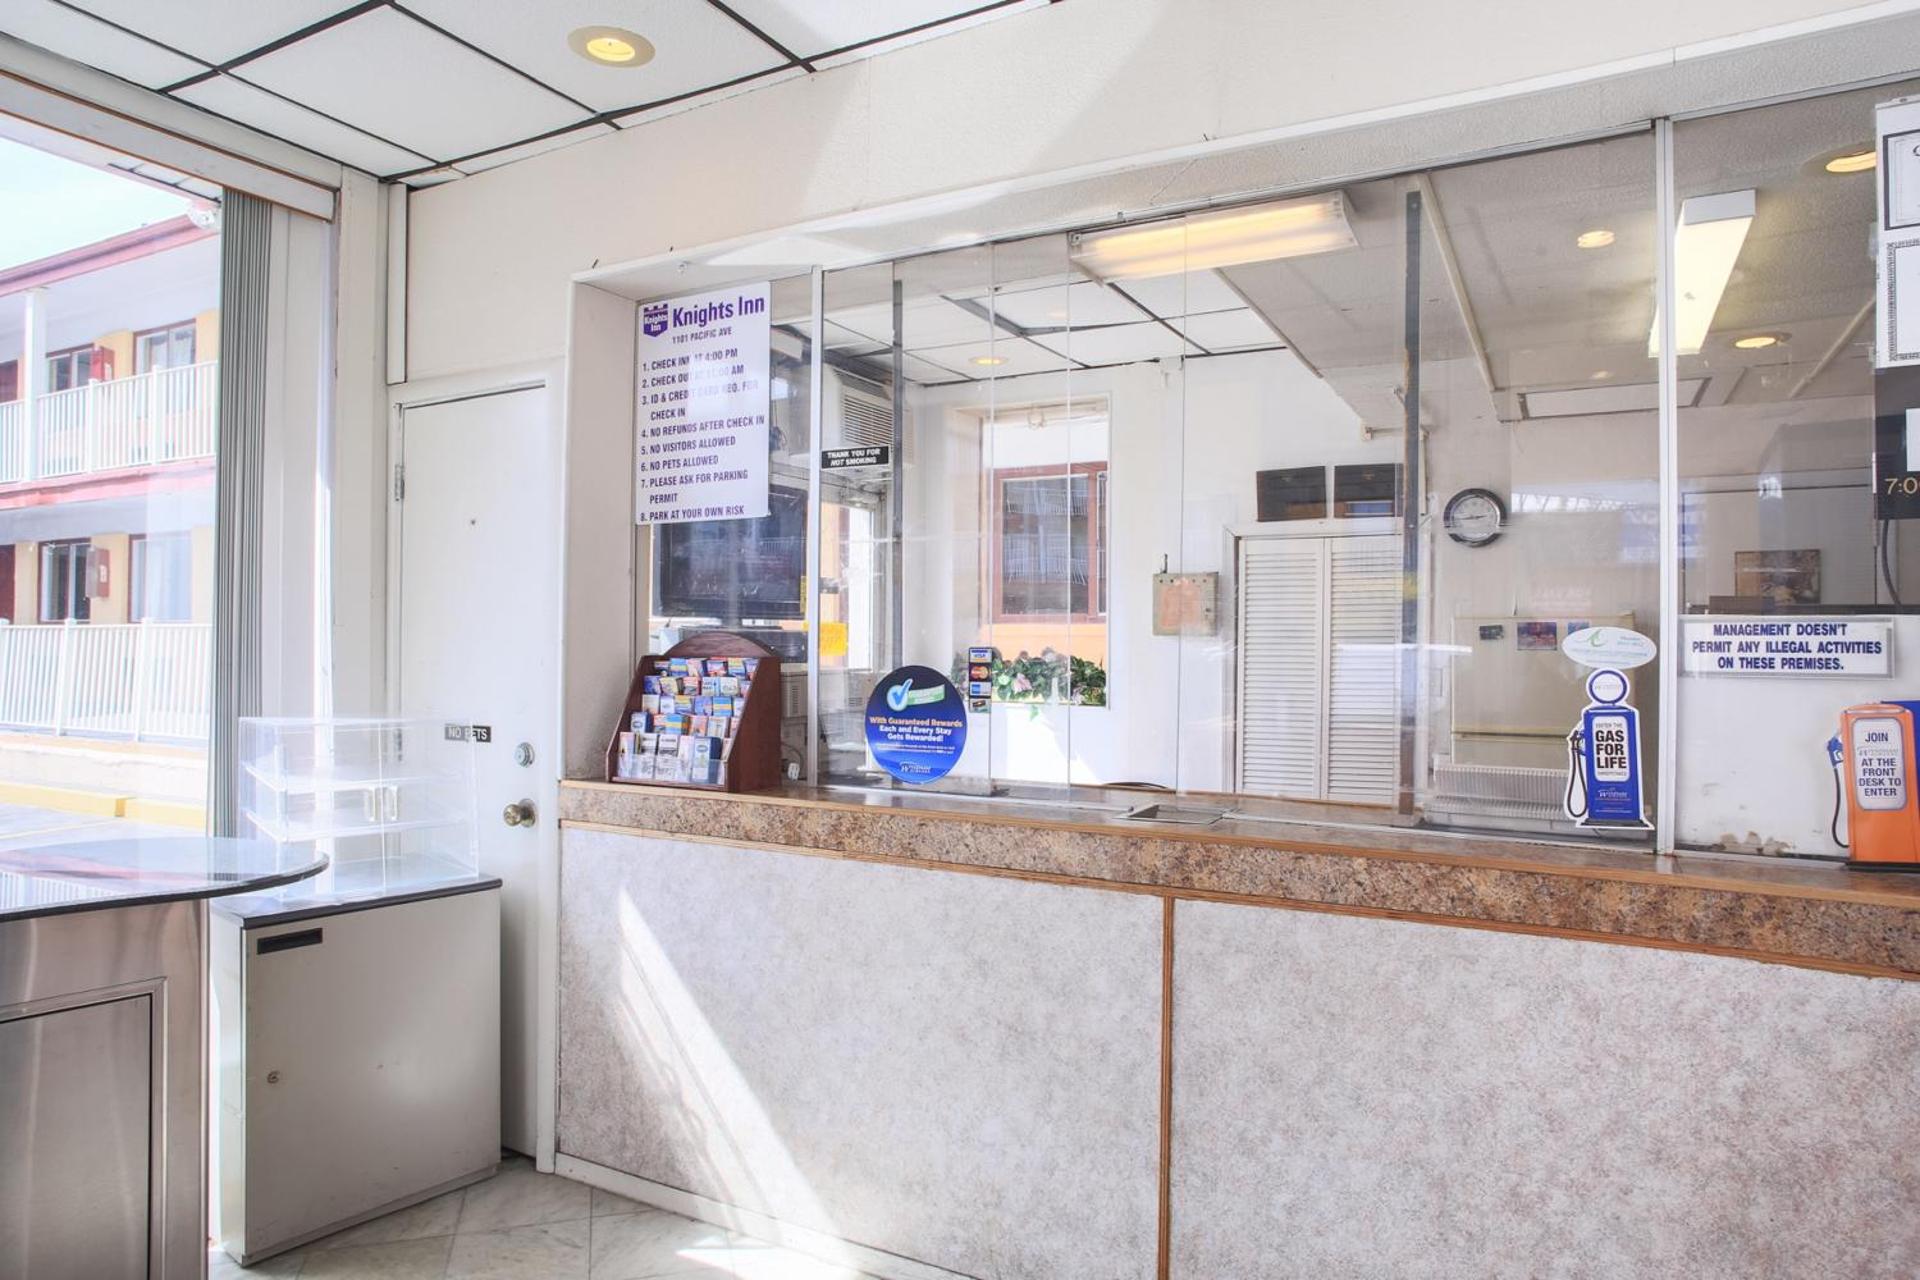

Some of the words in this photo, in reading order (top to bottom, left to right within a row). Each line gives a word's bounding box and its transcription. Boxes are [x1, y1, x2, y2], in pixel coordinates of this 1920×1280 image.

[673, 302, 734, 328] Knights
[738, 297, 765, 316] Inn
[672, 334, 688, 345] 1101
[691, 330, 716, 342] PACIFIC
[719, 327, 732, 337] AVE
[642, 362, 650, 372] 1.
[651, 358, 676, 370] CHECK
[705, 350, 723, 361] 4:00
[725, 348, 738, 359] PM
[642, 379, 650, 388] 2.
[651, 375, 676, 387] CHECK
[731, 364, 744, 375] AM
[642, 395, 650, 405] 3.
[651, 393, 658, 404] ID
[661, 392, 666, 403] &
[651, 409, 676, 420] CHECK
[678, 408, 685, 417] IN
[641, 429, 648, 438] 4.
[650, 428, 660, 437] NO
[663, 424, 697, 436] REFUNDS
[699, 420, 724, 431] AFTER
[727, 416, 754, 428] CHECK
[756, 415, 765, 425] IN
[641, 445, 648, 455] 5.
[650, 445, 660, 454] NO
[663, 440, 697, 452] VISITORS
[699, 436, 736, 448] ALLOWED
[827, 451, 849, 459] THANK
[851, 449, 865, 457] YOU
[641, 462, 648, 472] 6.
[650, 461, 660, 471] NO
[663, 459, 681, 470] PETS
[683, 455, 719, 468] ALLOWED
[845, 457, 877, 466] SMOKING
[641, 479, 648, 488] 7.
[650, 476, 677, 488] PLEASE
[680, 475, 694, 485] ASK
[696, 472, 711, 483] FOR
[714, 469, 748, 482] PARKING
[1885, 477, 1920, 495] 7:0
[650, 493, 678, 505] PERMIT
[641, 512, 648, 522] 8.
[650, 511, 669, 521] PARK
[671, 510, 679, 519] AT
[682, 508, 702, 519] YOUR
[704, 506, 723, 517] OWN
[726, 505, 745, 516] RISK
[1713, 624, 1791, 636] MANAGEMENT
[1797, 624, 1848, 636] DOESN'T
[1692, 641, 1732, 653] PERMIT
[1737, 641, 1760, 653] ANY
[1765, 641, 1812, 653] ILLEGAL
[1817, 642, 1882, 654] ACTIVITIES
[1718, 656, 1733, 669] ON
[1739, 657, 1775, 669] THESE
[1781, 657, 1844, 670] PREMISES.
[869, 716, 887, 724] With
[888, 717, 930, 726] Guaranteed
[931, 718, 963, 728] Rewards
[448, 727, 461, 738] NO
[887, 733, 904, 741] Gets
[913, 726, 933, 736] Every
[935, 727, 952, 736] Stay
[1595, 730, 1624, 742] GAS
[1865, 732, 1888, 742] JOIN
[1596, 743, 1624, 755] FOR
[1597, 756, 1627, 768] LIFE
[1861, 758, 1872, 766] AT
[1877, 758, 1896, 766] THE
[1863, 768, 1896, 776] FRONT
[1859, 778, 1884, 786] DESK
[1888, 778, 1901, 786] TO
[1864, 788, 1897, 796] ENTER
